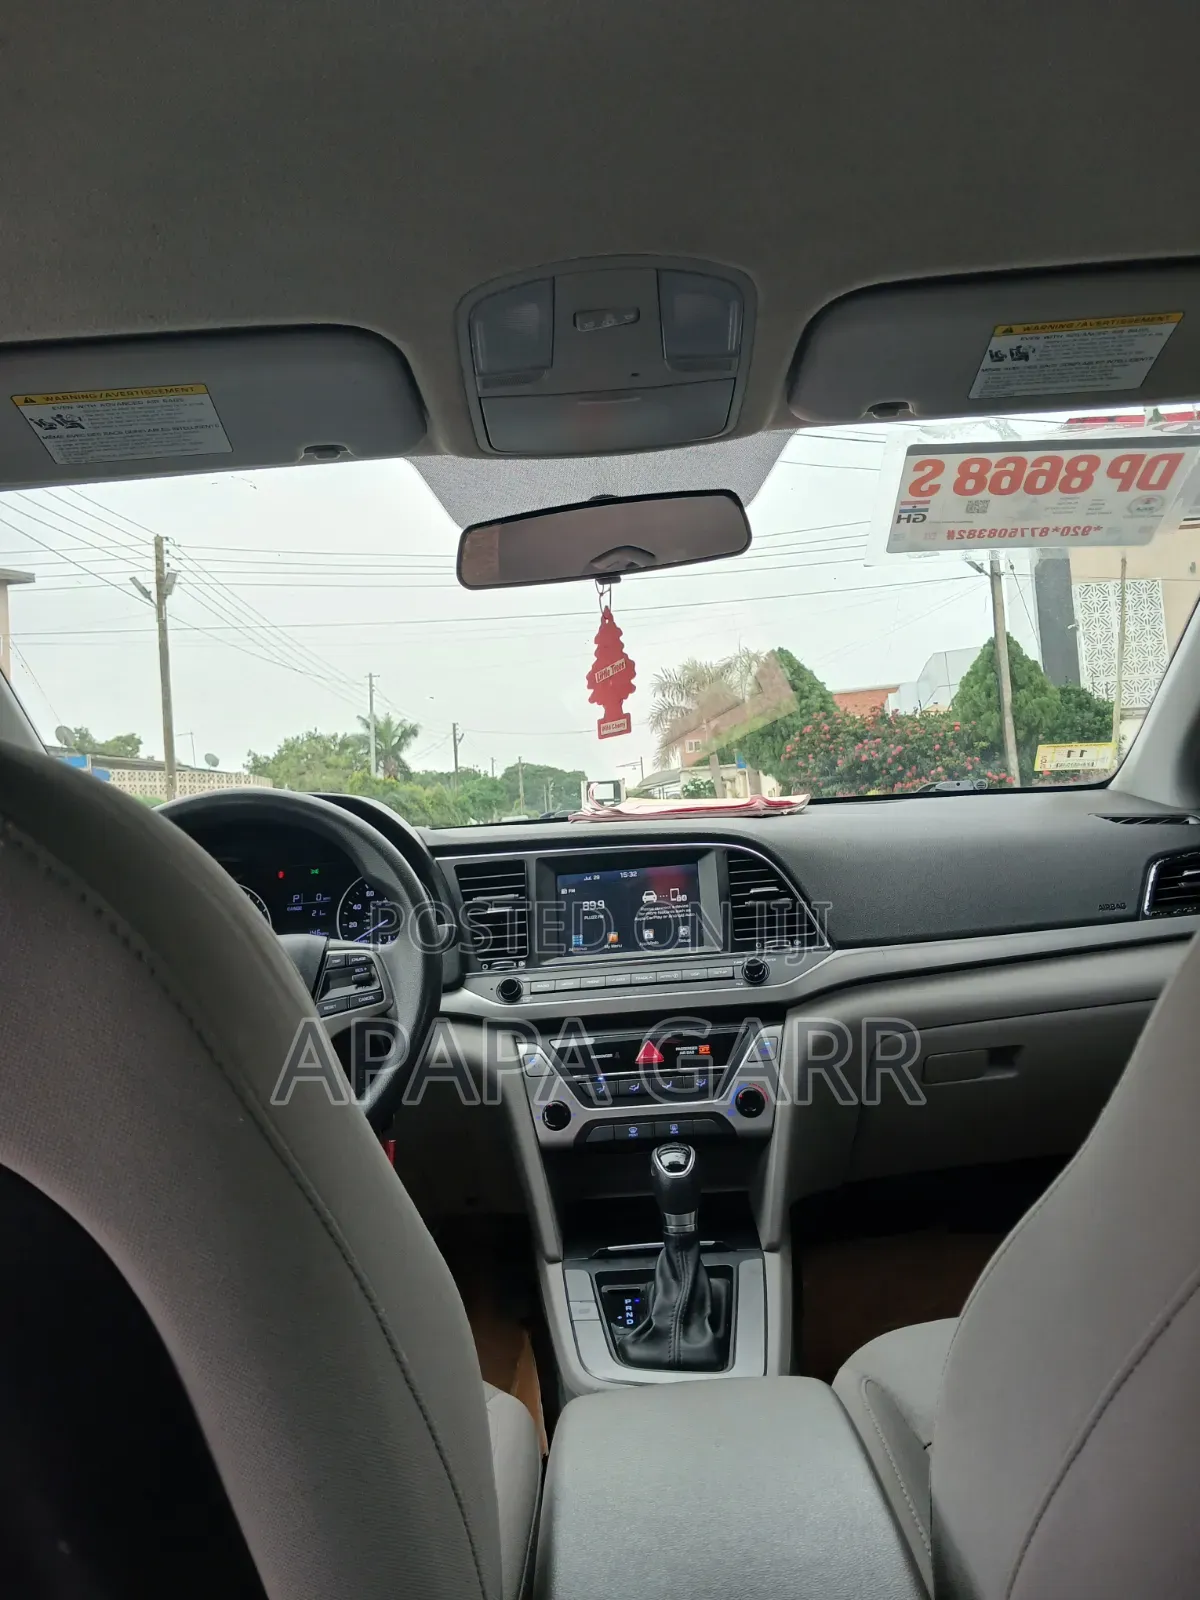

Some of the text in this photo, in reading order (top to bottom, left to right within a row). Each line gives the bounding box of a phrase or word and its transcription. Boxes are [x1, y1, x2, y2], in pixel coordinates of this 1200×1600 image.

[292, 894, 300, 903] P
[315, 893, 322, 901] 0
[582, 899, 605, 911] 89.9
[358, 995, 375, 1003] CANCEL
